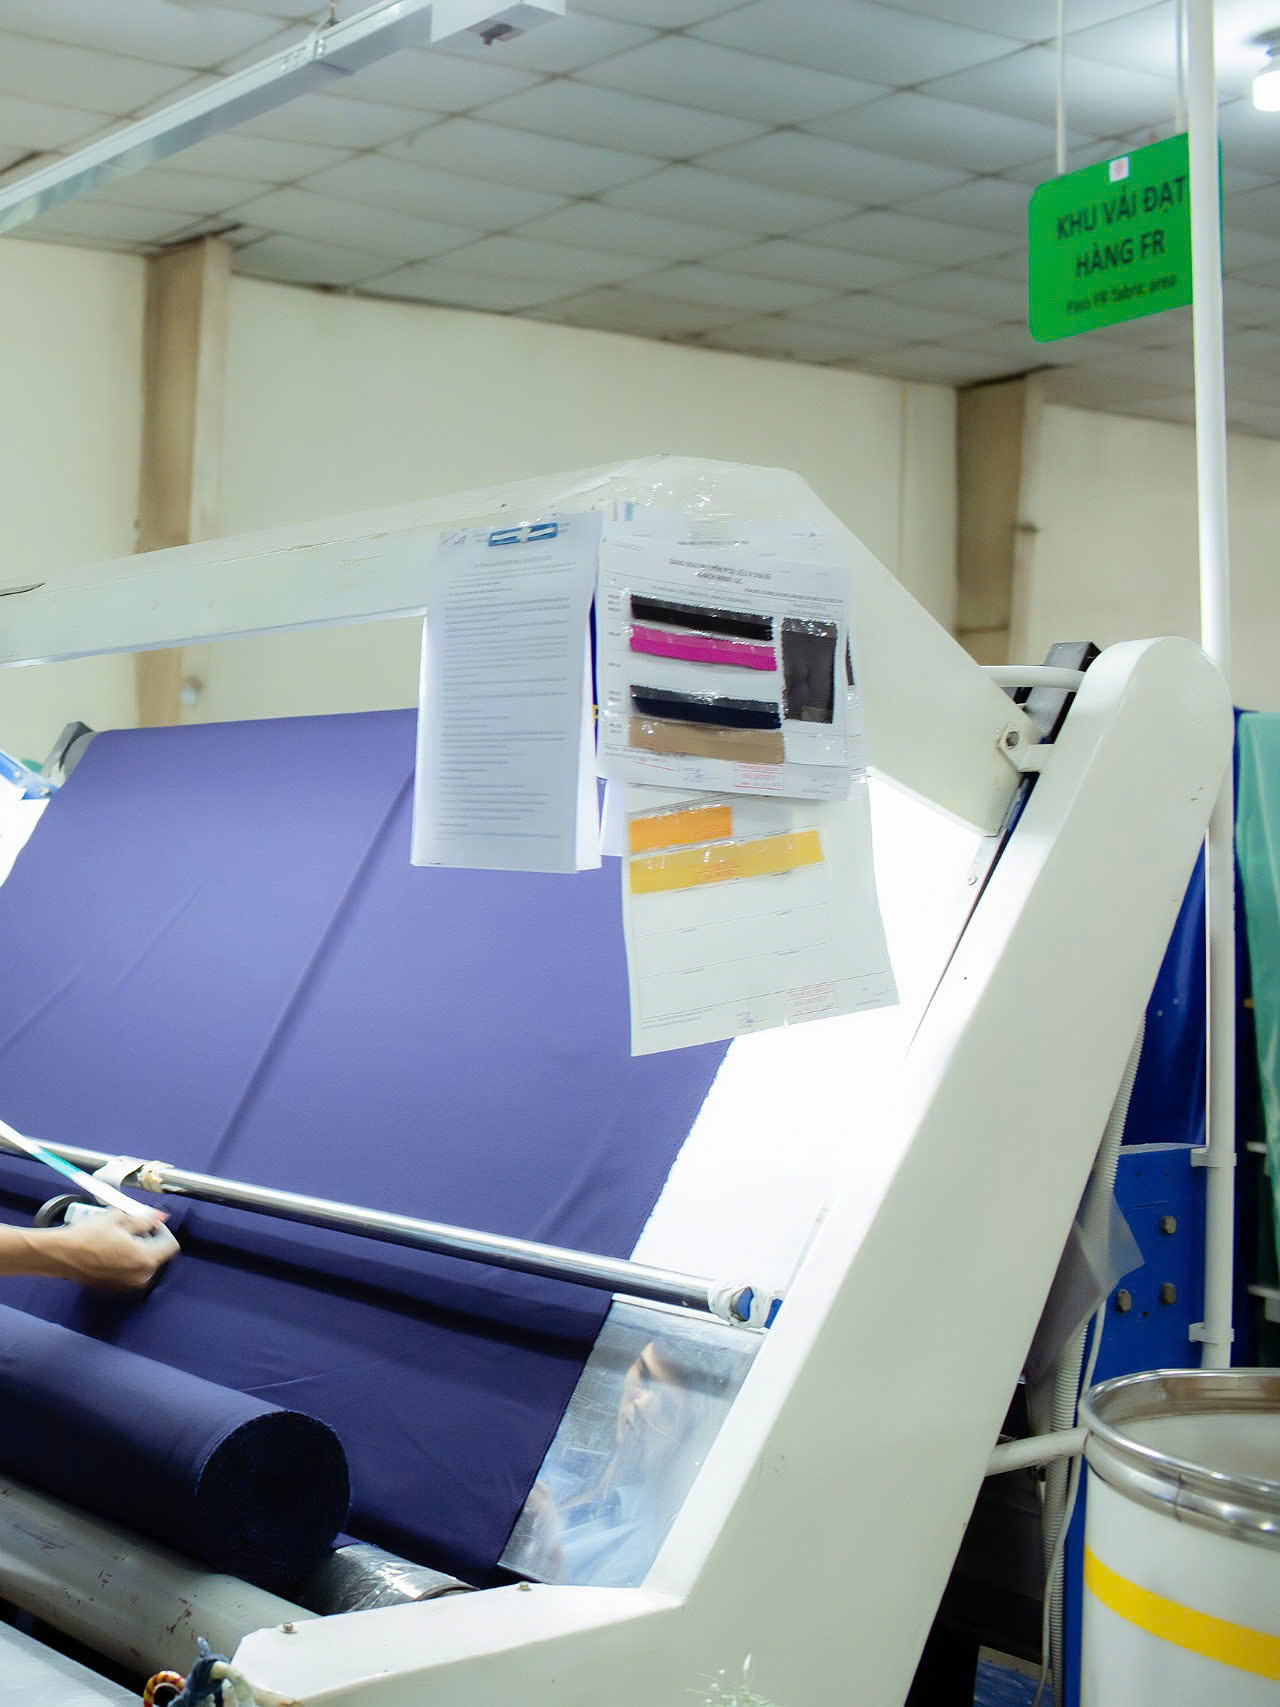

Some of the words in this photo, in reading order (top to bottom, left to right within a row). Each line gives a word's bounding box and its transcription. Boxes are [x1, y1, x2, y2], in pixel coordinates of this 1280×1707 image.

[1056, 206, 1097, 240] KHU
[1075, 238, 1133, 278] HÀNG
[1139, 229, 1166, 258] FR
